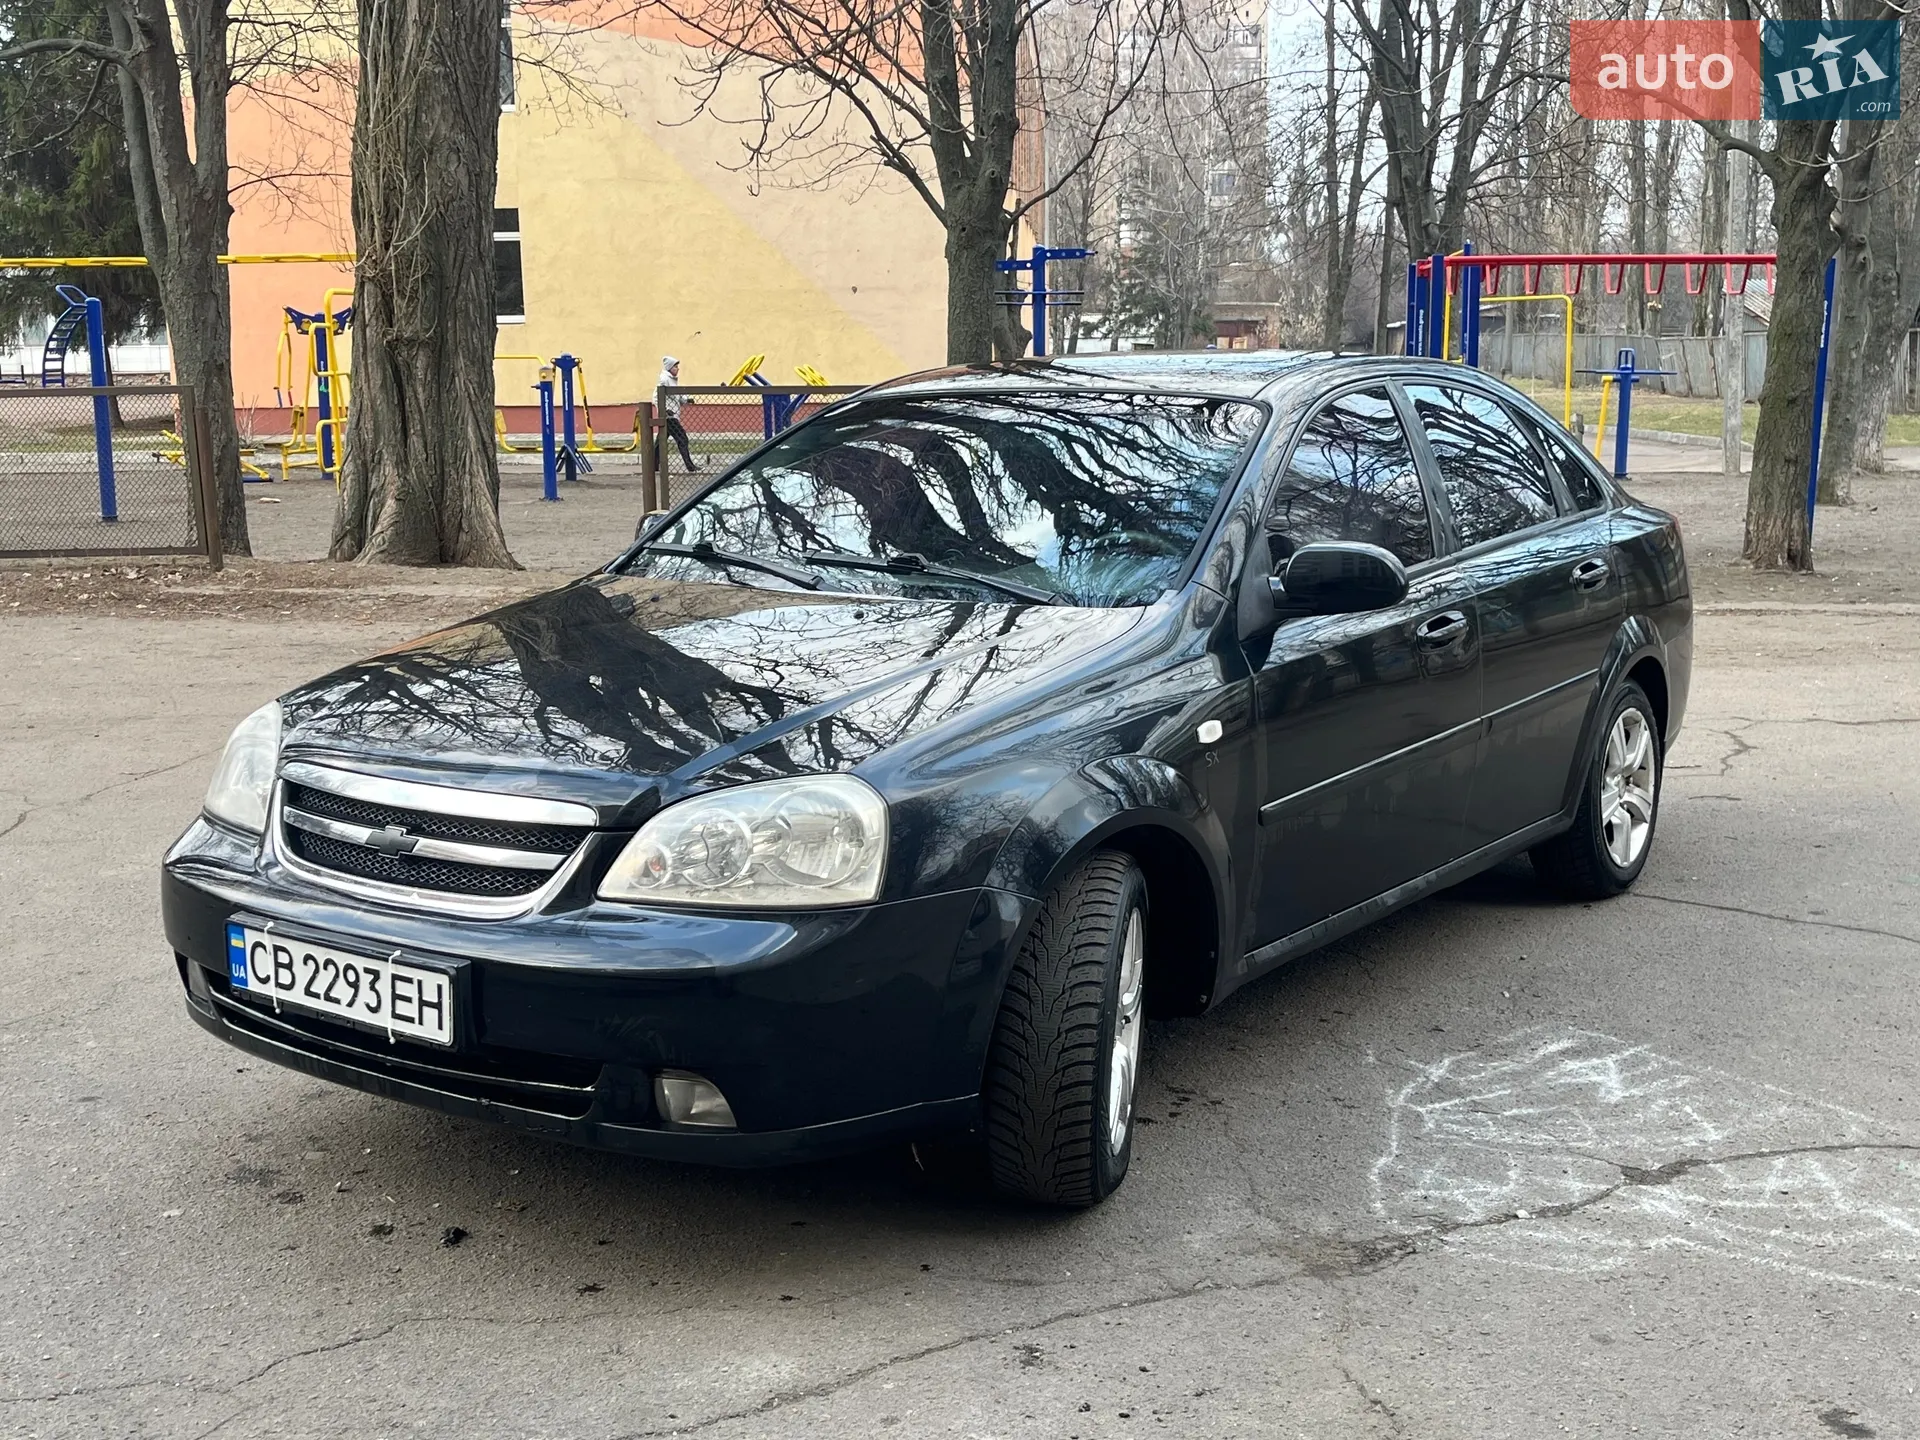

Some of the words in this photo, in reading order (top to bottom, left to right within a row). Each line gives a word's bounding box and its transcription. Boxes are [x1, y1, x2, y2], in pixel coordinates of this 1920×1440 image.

[1205, 749, 1220, 768] SX
[232, 963, 246, 979] UA
[250, 940, 296, 991] CB
[302, 952, 382, 1014] 2293
[391, 973, 443, 1031] EH
